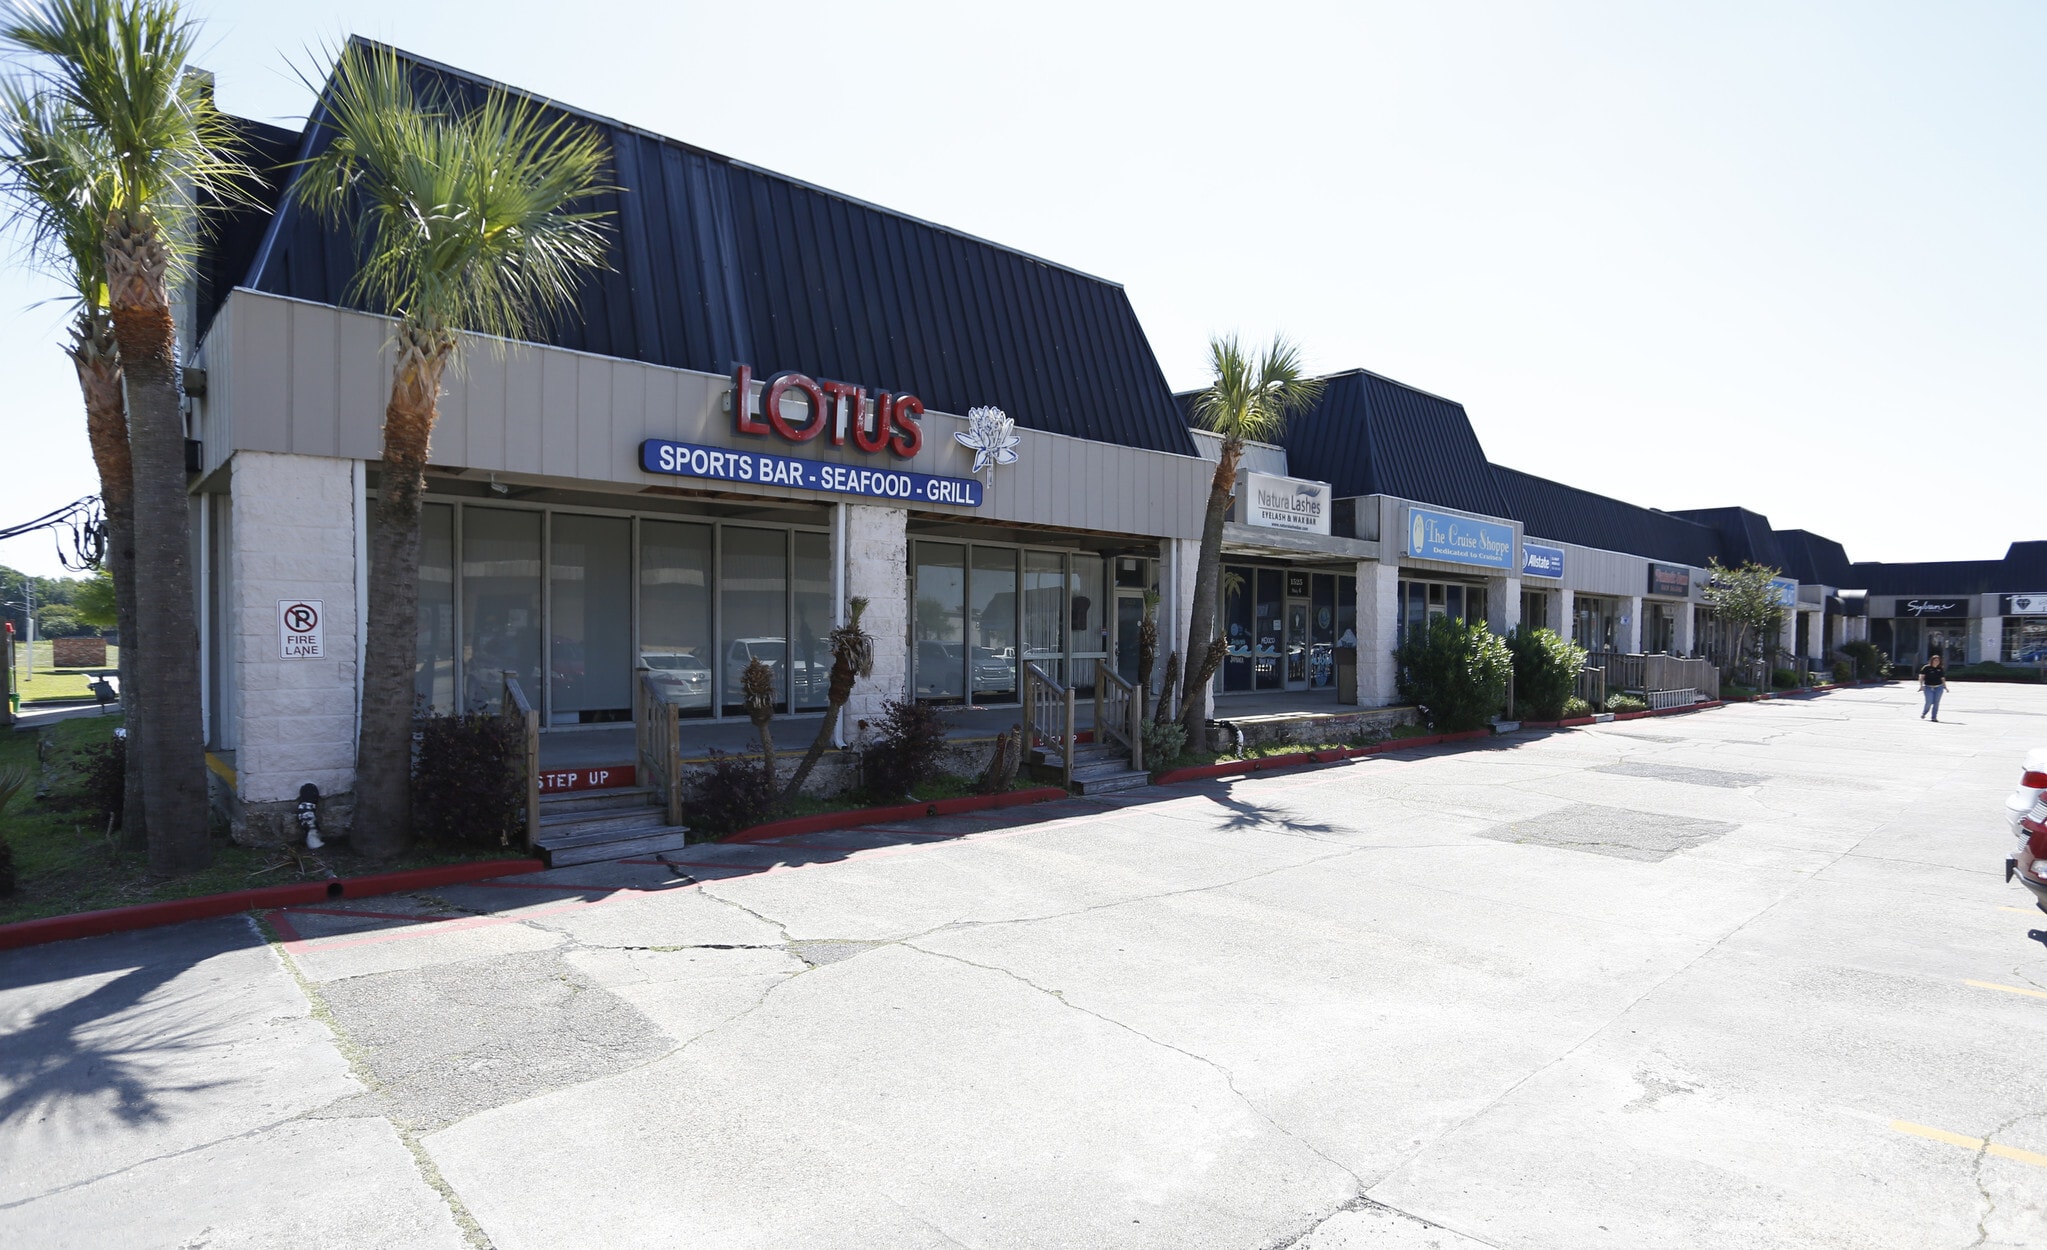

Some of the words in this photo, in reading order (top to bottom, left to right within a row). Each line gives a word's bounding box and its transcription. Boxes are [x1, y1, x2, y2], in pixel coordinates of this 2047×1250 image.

[736, 364, 925, 459] LOTUS
[659, 445, 753, 480] SPORTS
[759, 461, 804, 486] BAR
[821, 466, 912, 498] SEAFOOD
[926, 479, 976, 505] GRILL
[1262, 511, 1286, 521] EYELASH
[1293, 514, 1305, 523] WAX
[1305, 517, 1317, 525] BAR
[1426, 519, 1445, 543] The
[1449, 524, 1477, 549] Cruise
[1480, 529, 1510, 557] Shoppe
[1433, 547, 1468, 558] Dedicated
[1479, 553, 1503, 562] Cruises
[1528, 554, 1550, 569] Allstate
[287, 635, 316, 644] FIRE
[285, 645, 319, 655] LANE
[538, 773, 577, 789] STEP
[589, 770, 609, 785] UP
